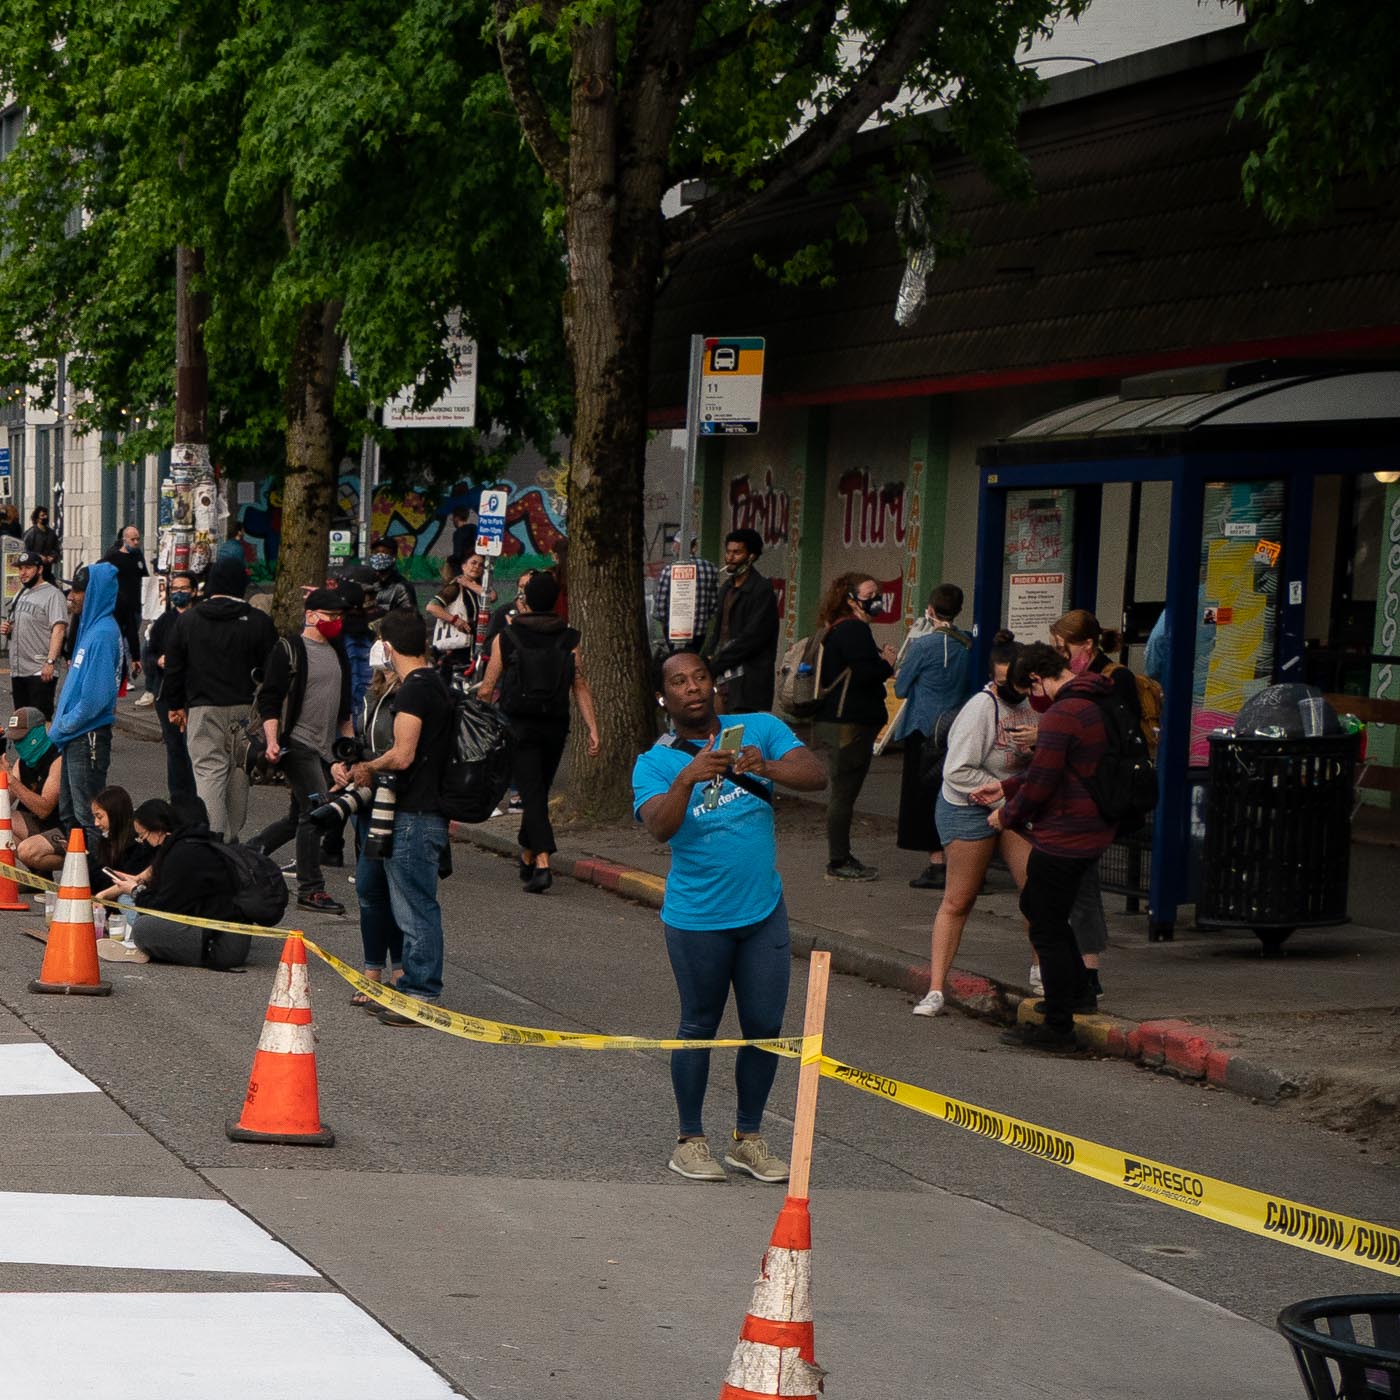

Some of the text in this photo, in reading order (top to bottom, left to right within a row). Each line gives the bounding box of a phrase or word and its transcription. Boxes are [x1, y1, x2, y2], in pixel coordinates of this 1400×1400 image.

[708, 383, 718, 393] 11
[849, 1067, 898, 1097] PRESCO
[1141, 1163, 1204, 1199] PRESCO
